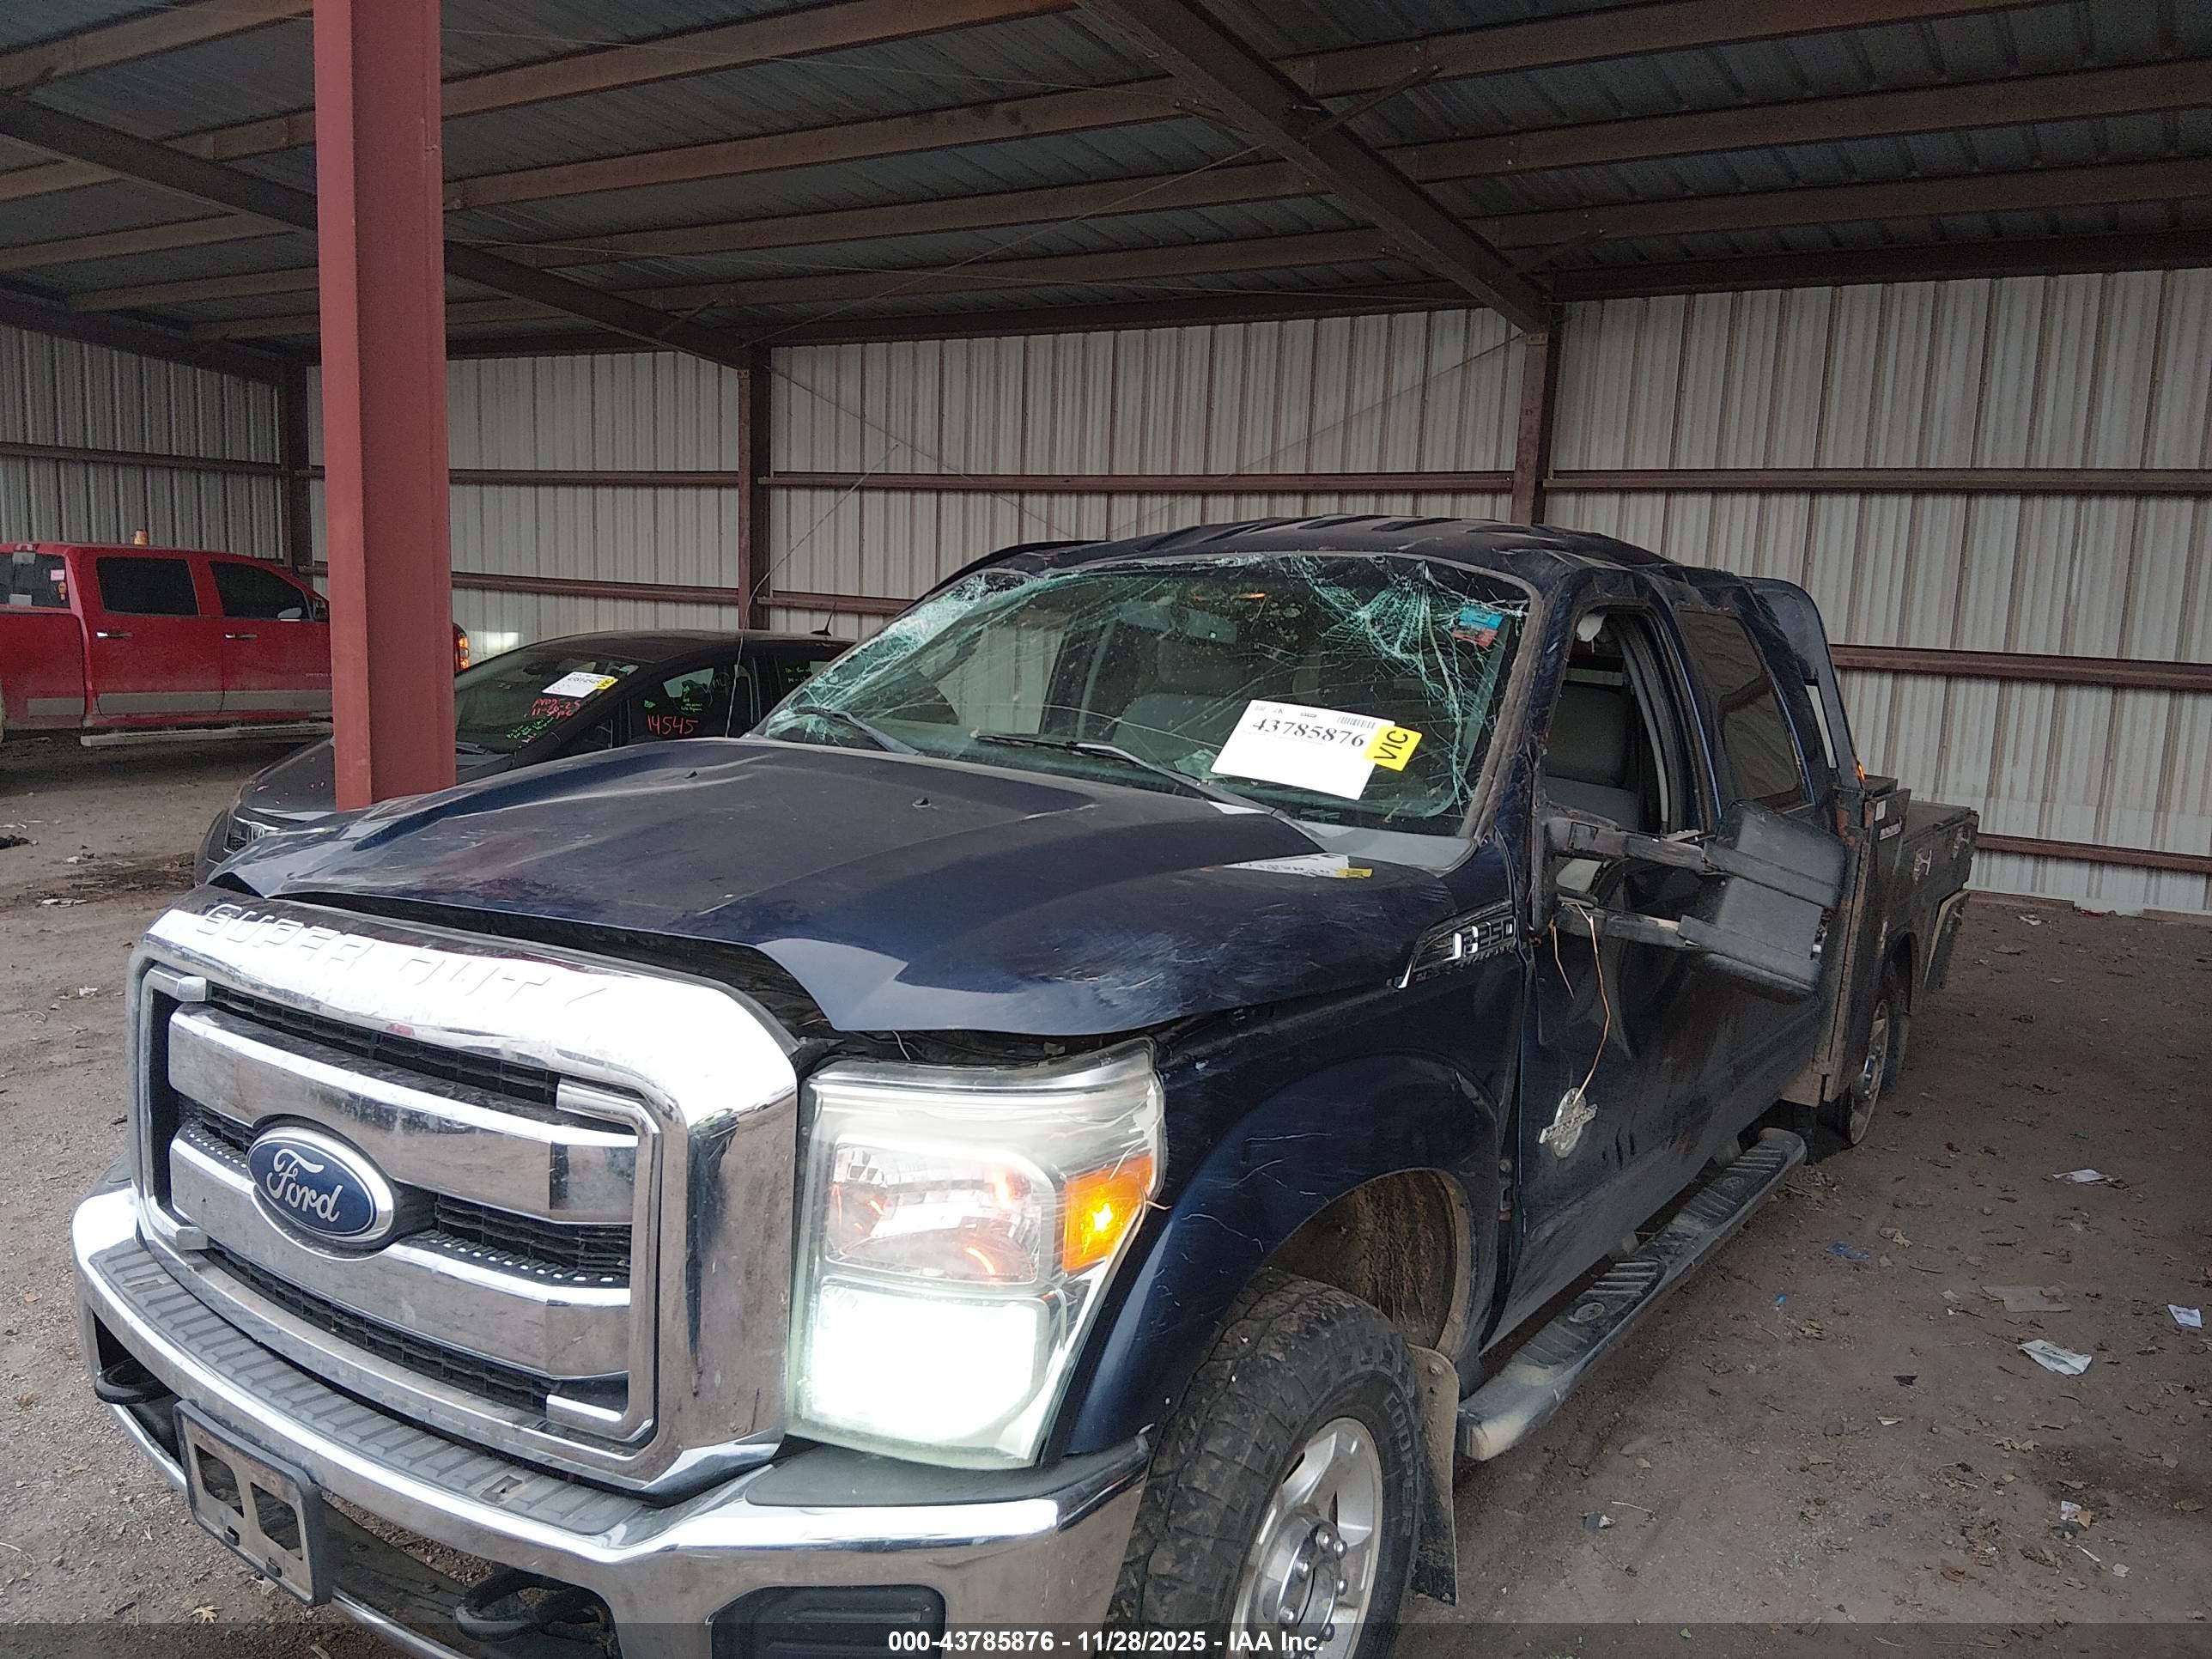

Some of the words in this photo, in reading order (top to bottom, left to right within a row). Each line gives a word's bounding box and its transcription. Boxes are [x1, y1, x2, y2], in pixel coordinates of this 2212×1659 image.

[647, 714, 699, 735] 14545
[1253, 718, 1367, 748] 43785876
[1374, 730, 1409, 761] VIC
[196, 903, 376, 971] SUPER
[266, 1148, 343, 1223] Ford
[1382, 1391, 1416, 1537] COOPER
